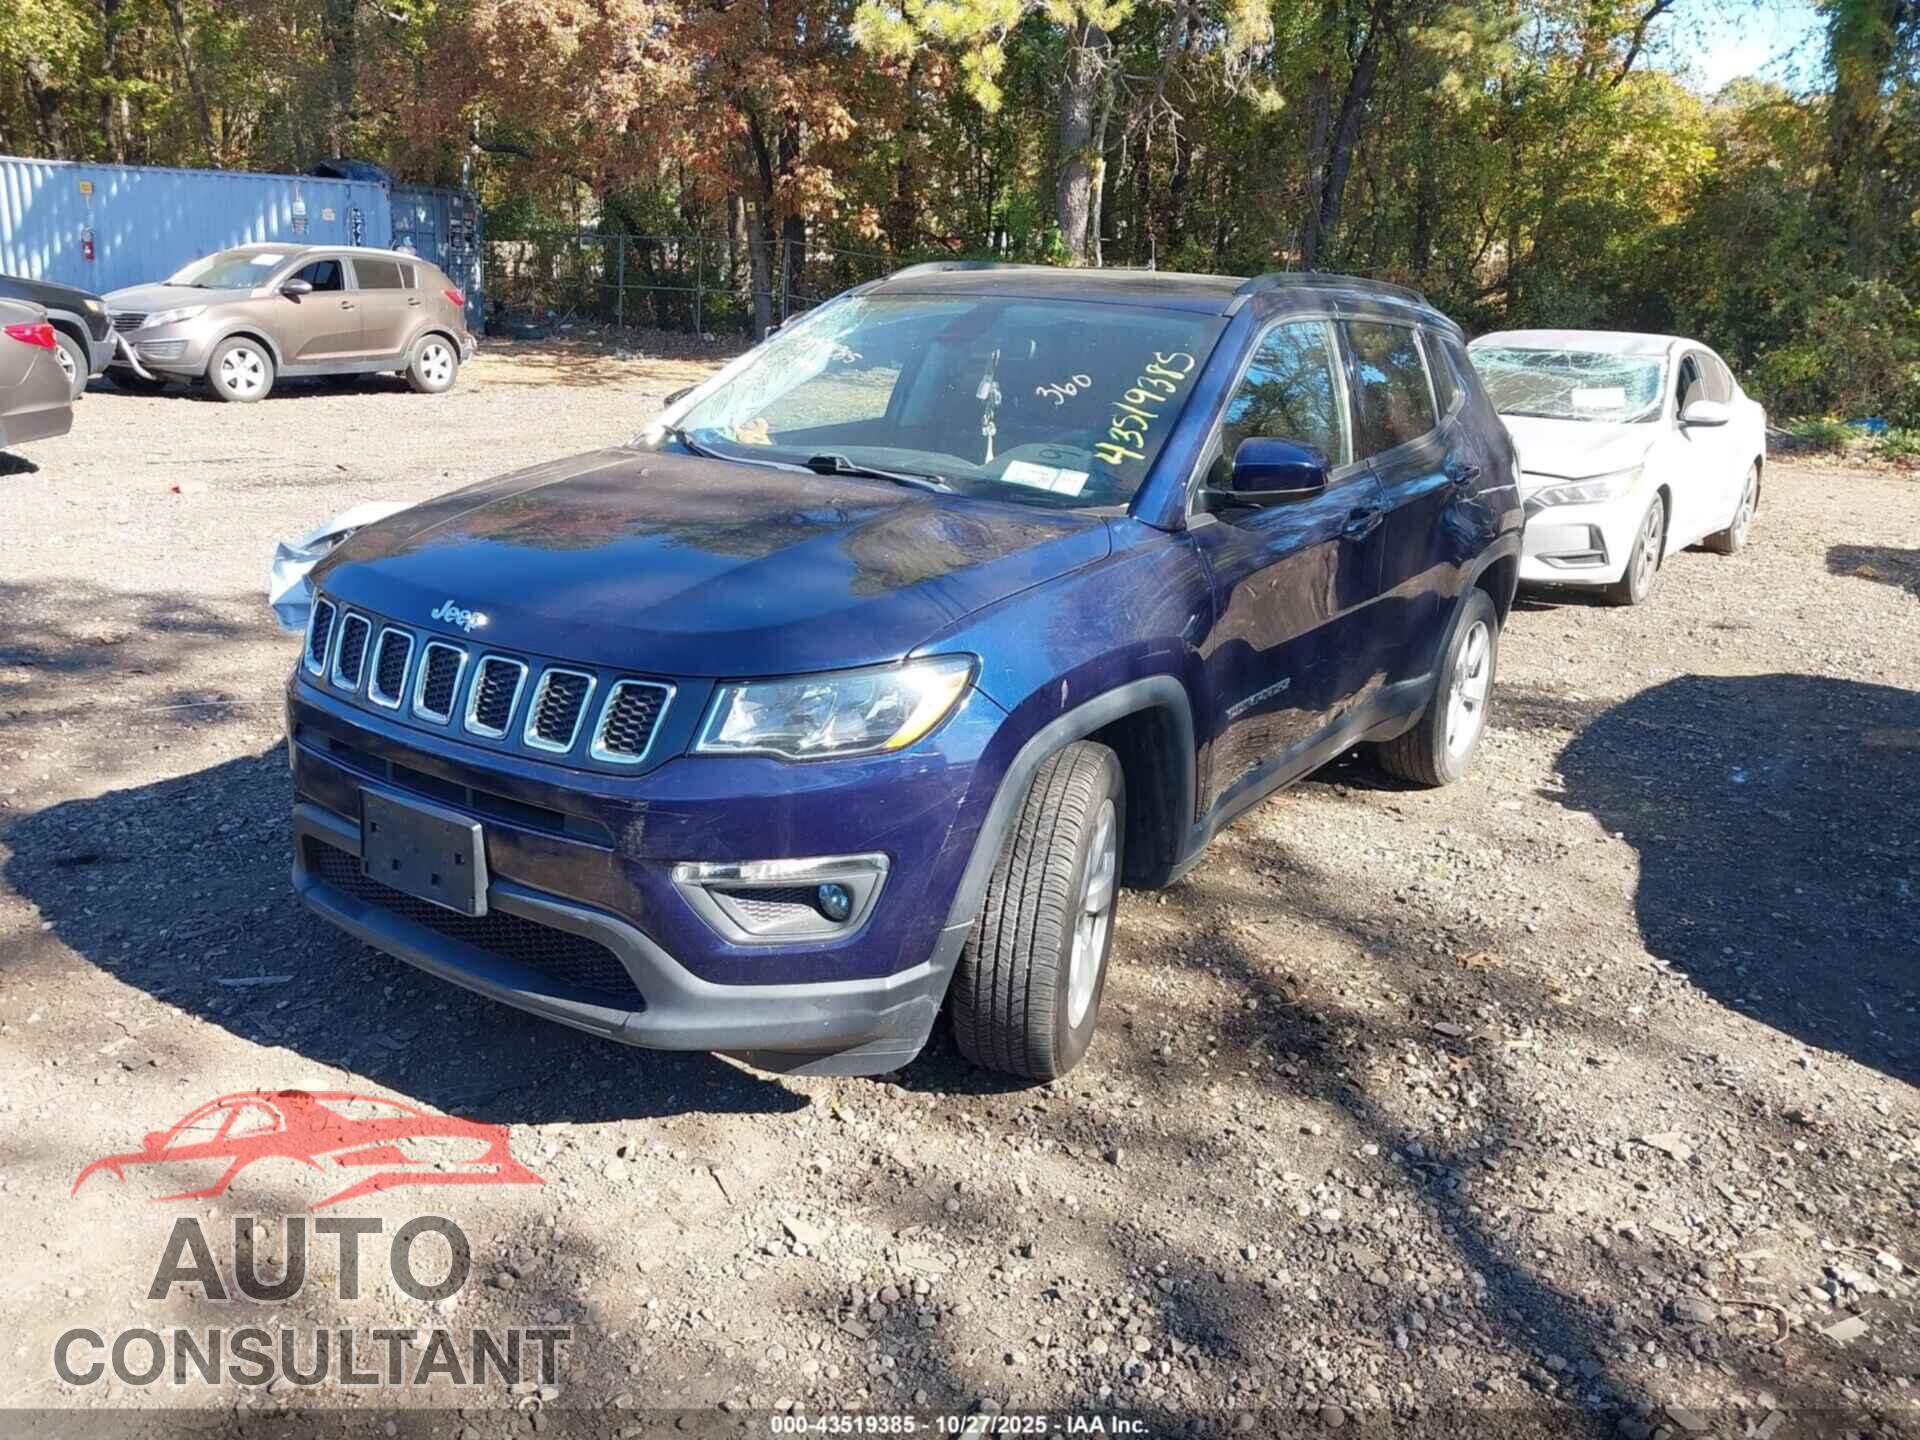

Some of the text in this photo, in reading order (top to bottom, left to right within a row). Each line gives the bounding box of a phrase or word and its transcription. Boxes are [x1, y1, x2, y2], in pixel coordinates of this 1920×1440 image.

[1036, 374, 1092, 405] 360
[1094, 352, 1195, 464] 43519385
[431, 600, 488, 633] Jeep
